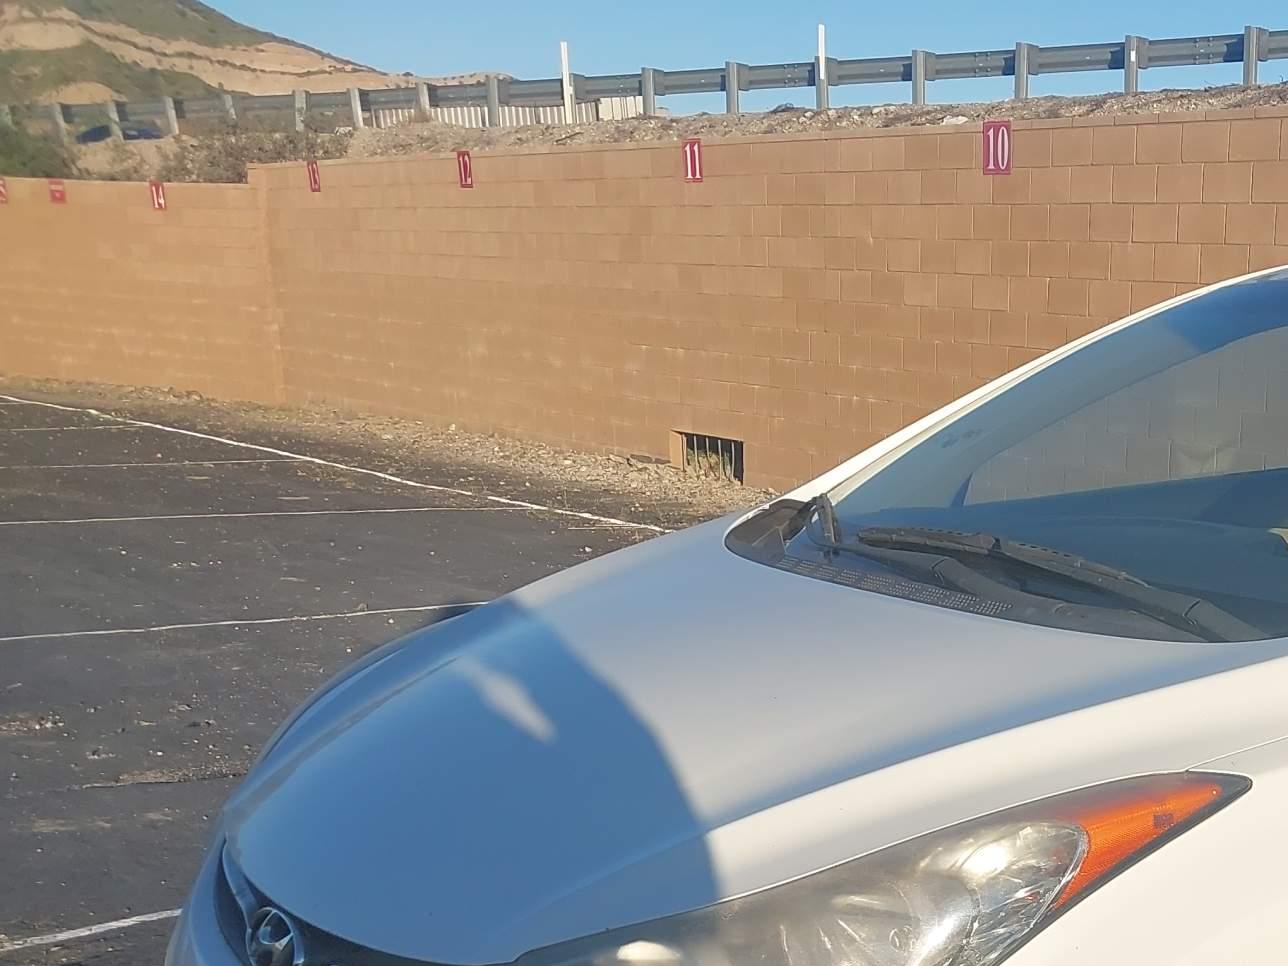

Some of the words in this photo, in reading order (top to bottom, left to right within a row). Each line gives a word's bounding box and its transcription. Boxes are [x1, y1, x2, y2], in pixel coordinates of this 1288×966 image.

[684, 142, 702, 179] 11
[986, 126, 1009, 170] 10
[459, 154, 472, 185] 12
[152, 185, 165, 208] 14
